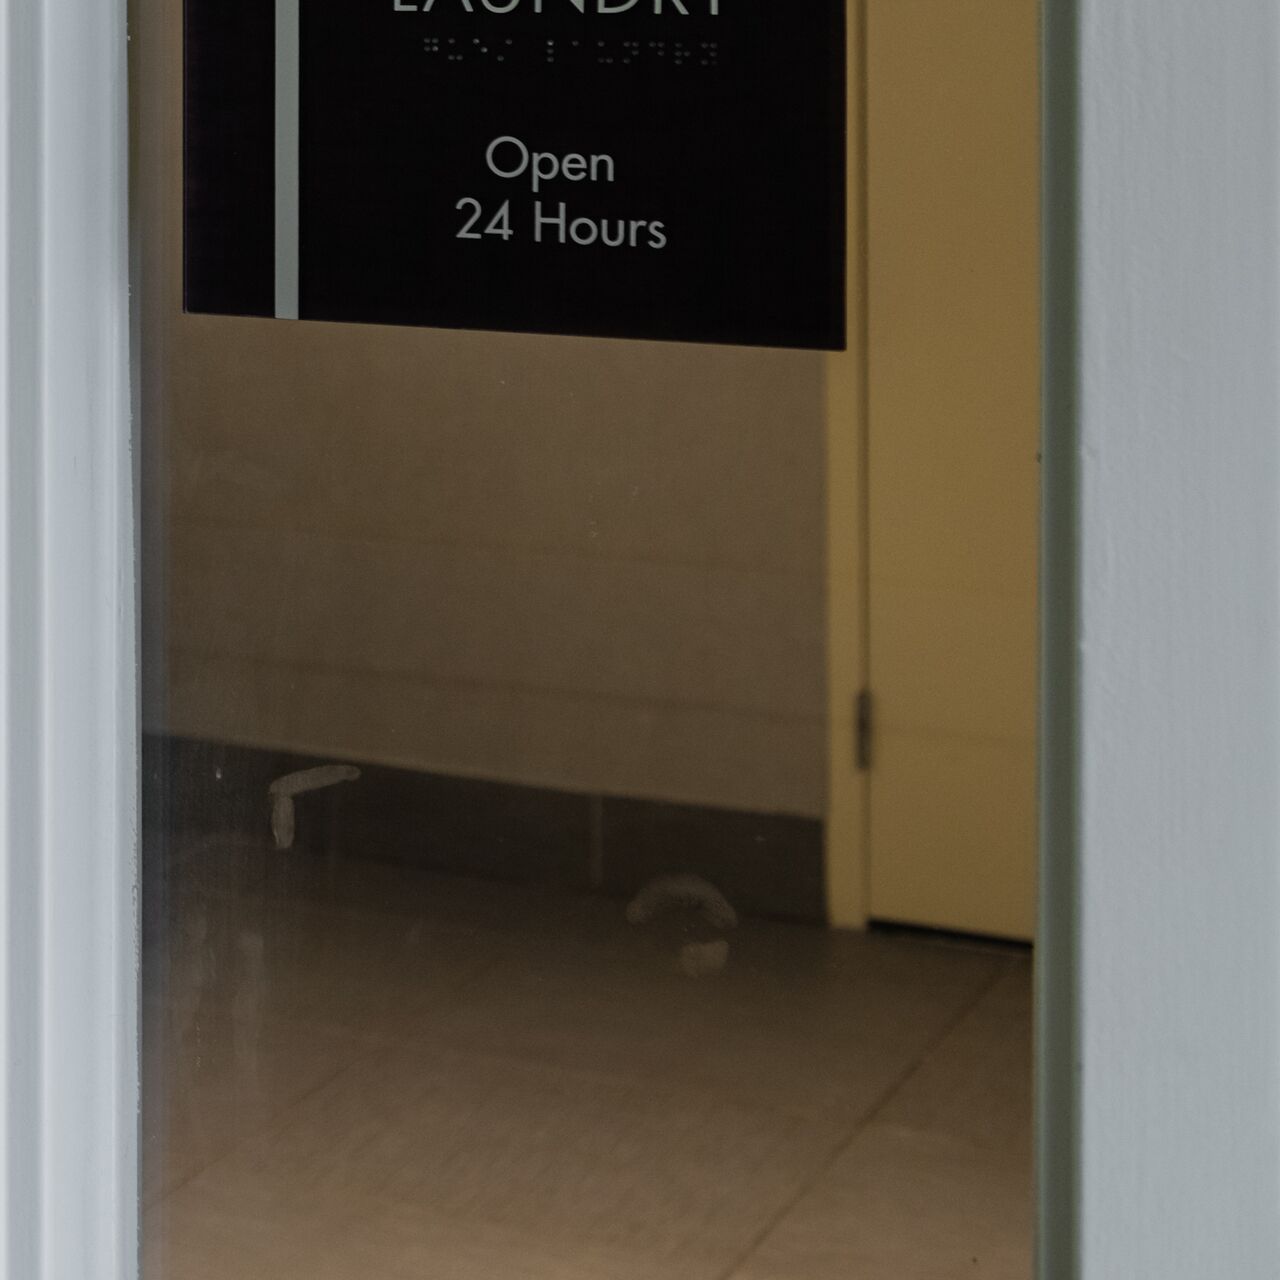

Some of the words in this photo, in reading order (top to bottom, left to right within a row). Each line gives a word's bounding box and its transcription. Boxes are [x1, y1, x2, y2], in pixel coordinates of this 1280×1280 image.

[486, 135, 616, 193] Open
[454, 197, 515, 241] 24
[534, 200, 668, 250] Hours
